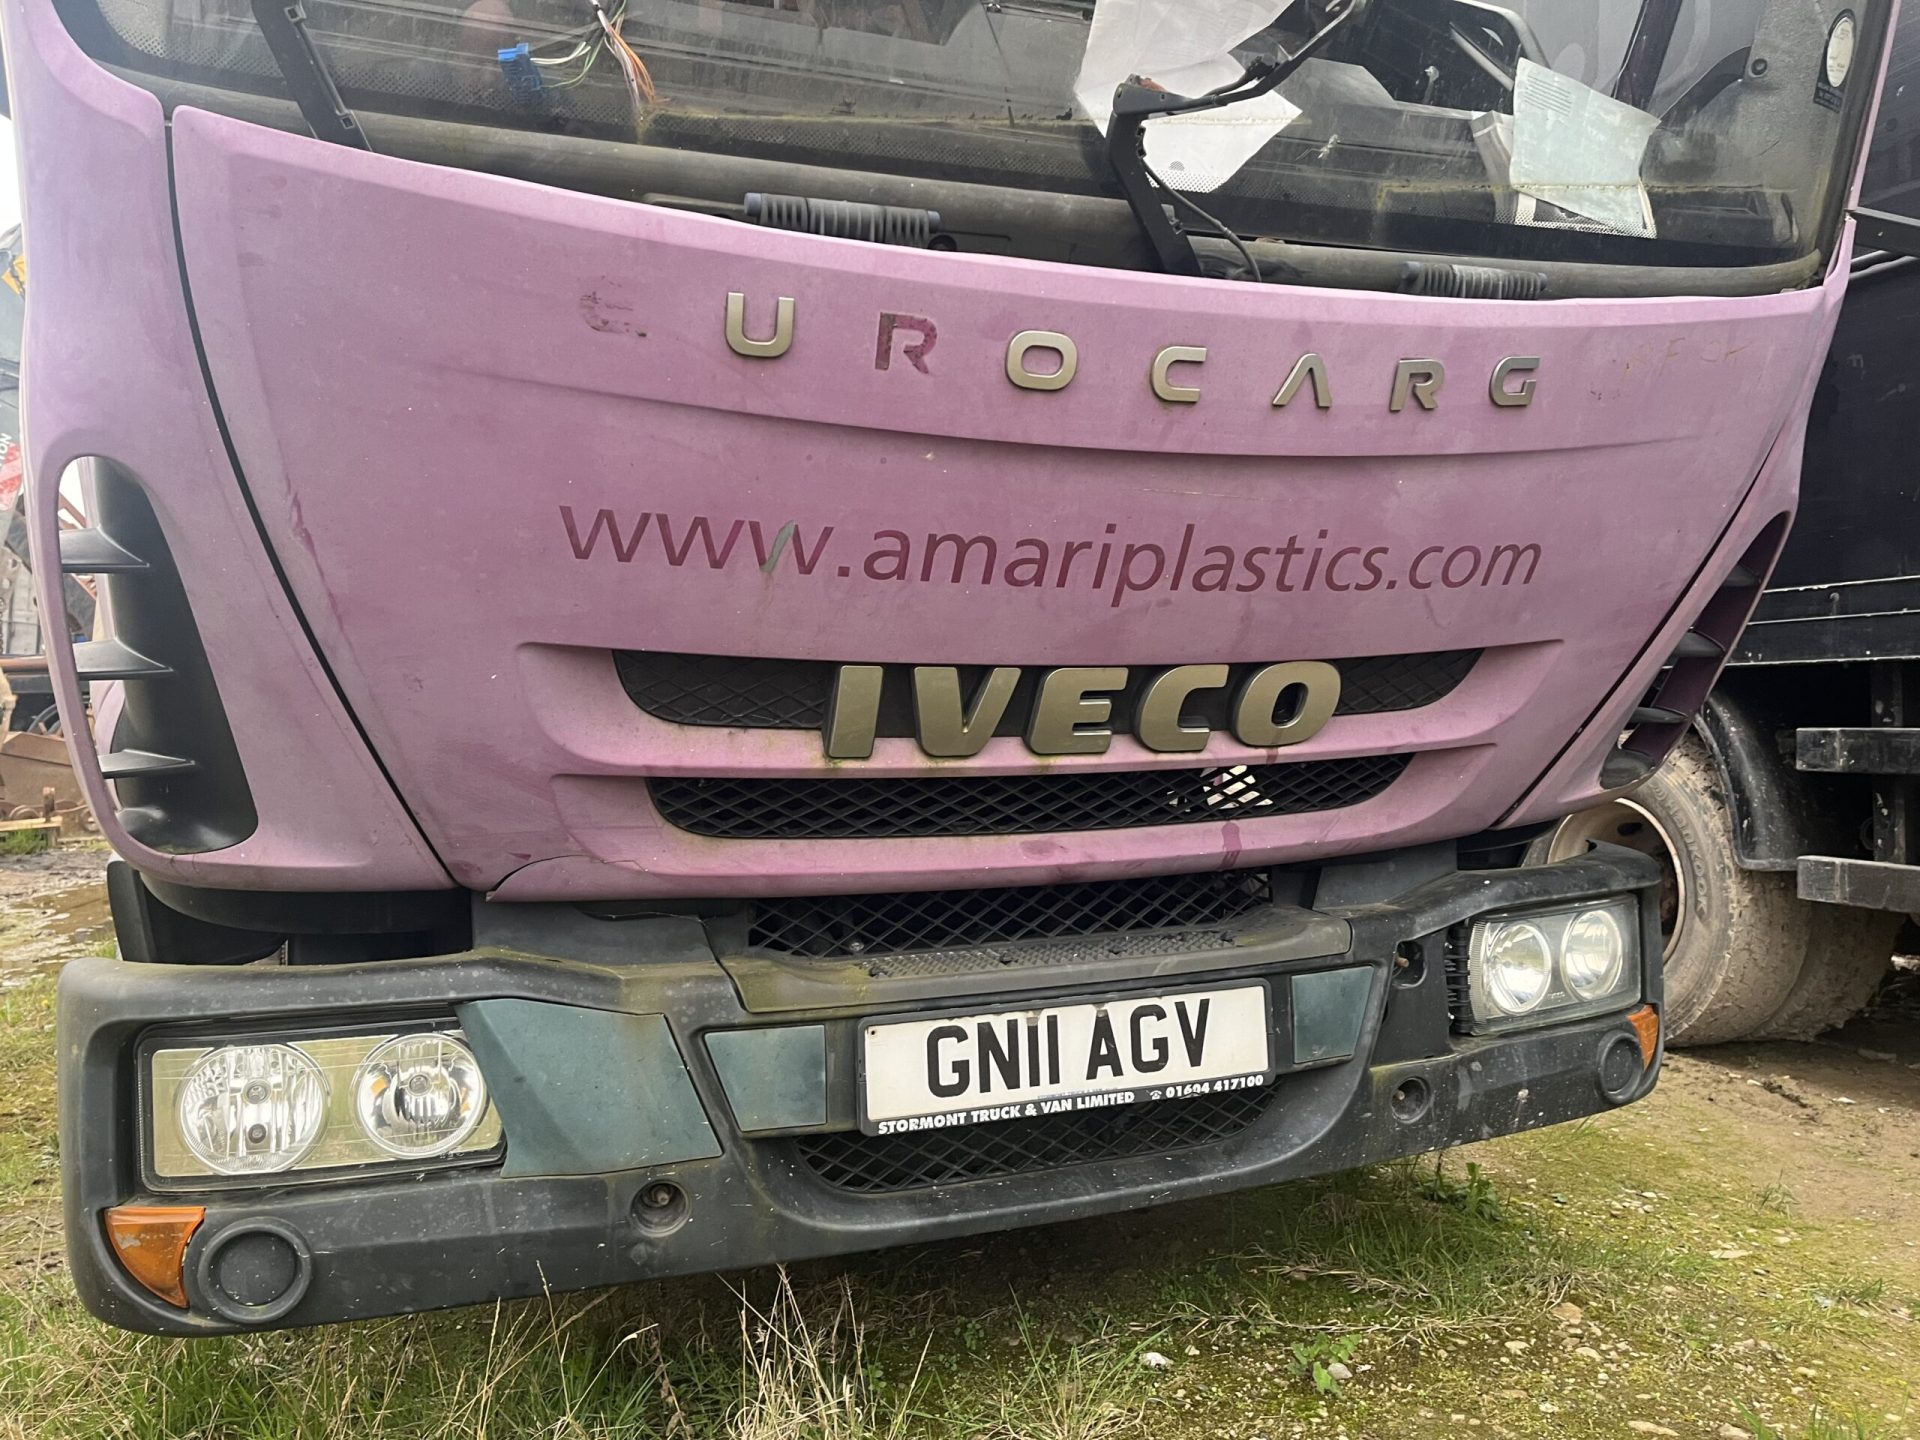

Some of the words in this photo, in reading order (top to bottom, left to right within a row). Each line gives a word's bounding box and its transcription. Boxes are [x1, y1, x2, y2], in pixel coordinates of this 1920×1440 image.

[559, 505, 1541, 607] www.amariplastics.com
[823, 660, 1341, 758] IVECO
[926, 1014, 1061, 1099] GN11
[1086, 998, 1211, 1081] AGV
[878, 1111, 967, 1135] STORMONT
[971, 1104, 1021, 1124] TRUCK
[1025, 1103, 1038, 1117] &
[1040, 1098, 1073, 1115] VAN
[1076, 1091, 1135, 1110] LIMITED
[1213, 1074, 1264, 1092] 417100
